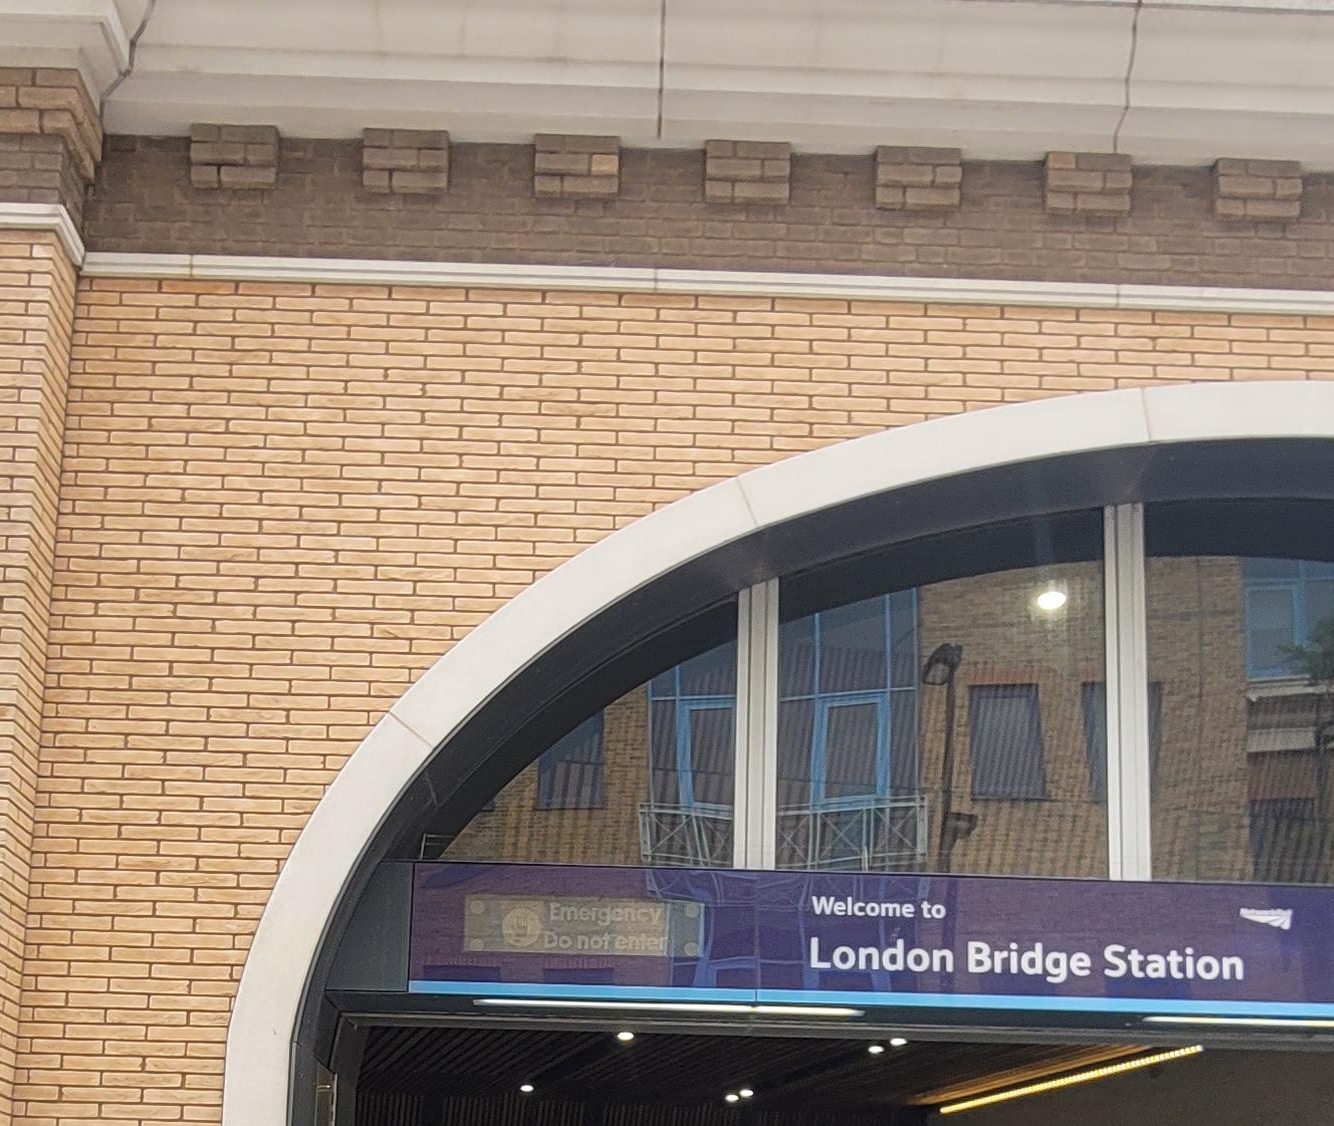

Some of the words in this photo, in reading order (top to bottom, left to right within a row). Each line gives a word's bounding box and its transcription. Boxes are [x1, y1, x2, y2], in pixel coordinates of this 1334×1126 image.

[548, 901, 662, 926] Emergency
[811, 894, 916, 918] Welcome
[921, 898, 947, 919] to
[543, 931, 572, 949] Do
[576, 933, 610, 951] not
[614, 934, 668, 952] enter
[809, 935, 955, 973] London
[967, 939, 1091, 984] Bridge
[1103, 944, 1245, 981] Station
